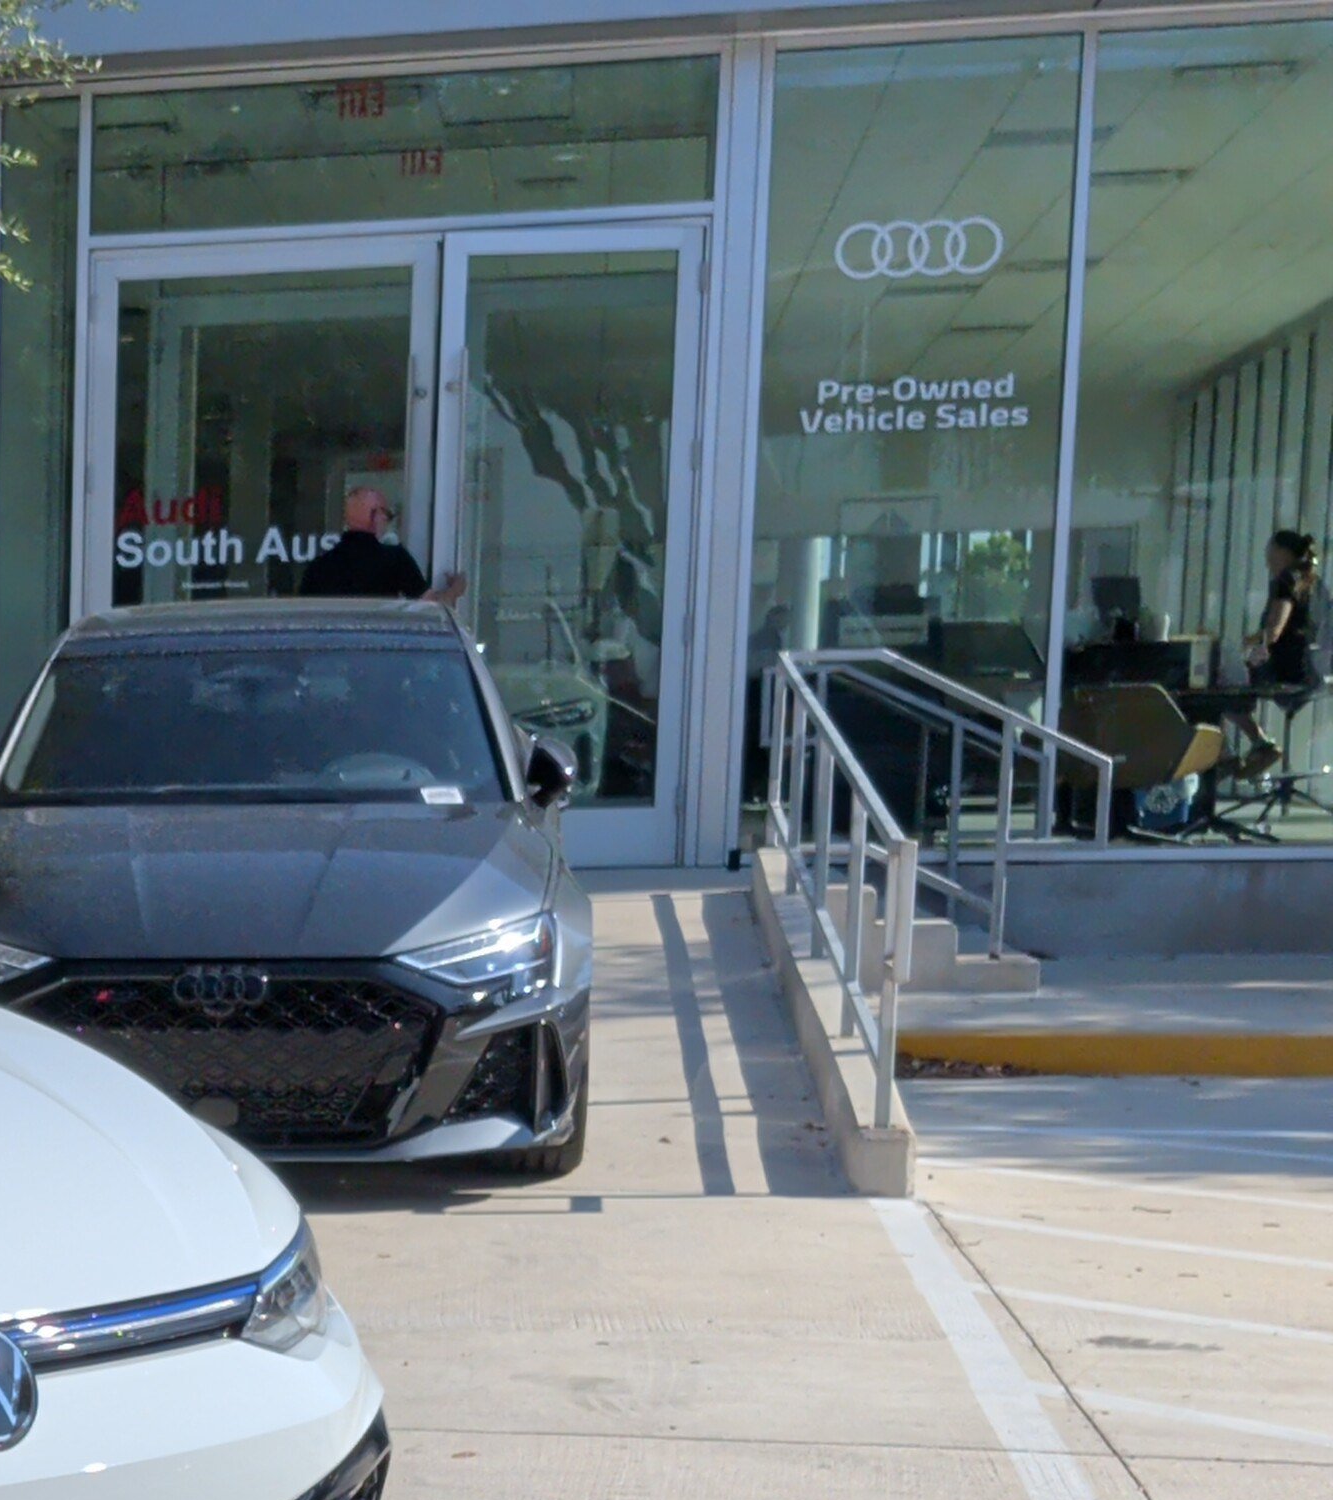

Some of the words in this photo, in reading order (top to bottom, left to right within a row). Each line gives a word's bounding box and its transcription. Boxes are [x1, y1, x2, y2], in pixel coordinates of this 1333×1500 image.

[818, 373, 1014, 404] Pre-Owned
[800, 405, 926, 434] Vehicle
[936, 403, 1029, 429] Sales
[118, 487, 222, 527] Audi
[116, 527, 243, 568] South
